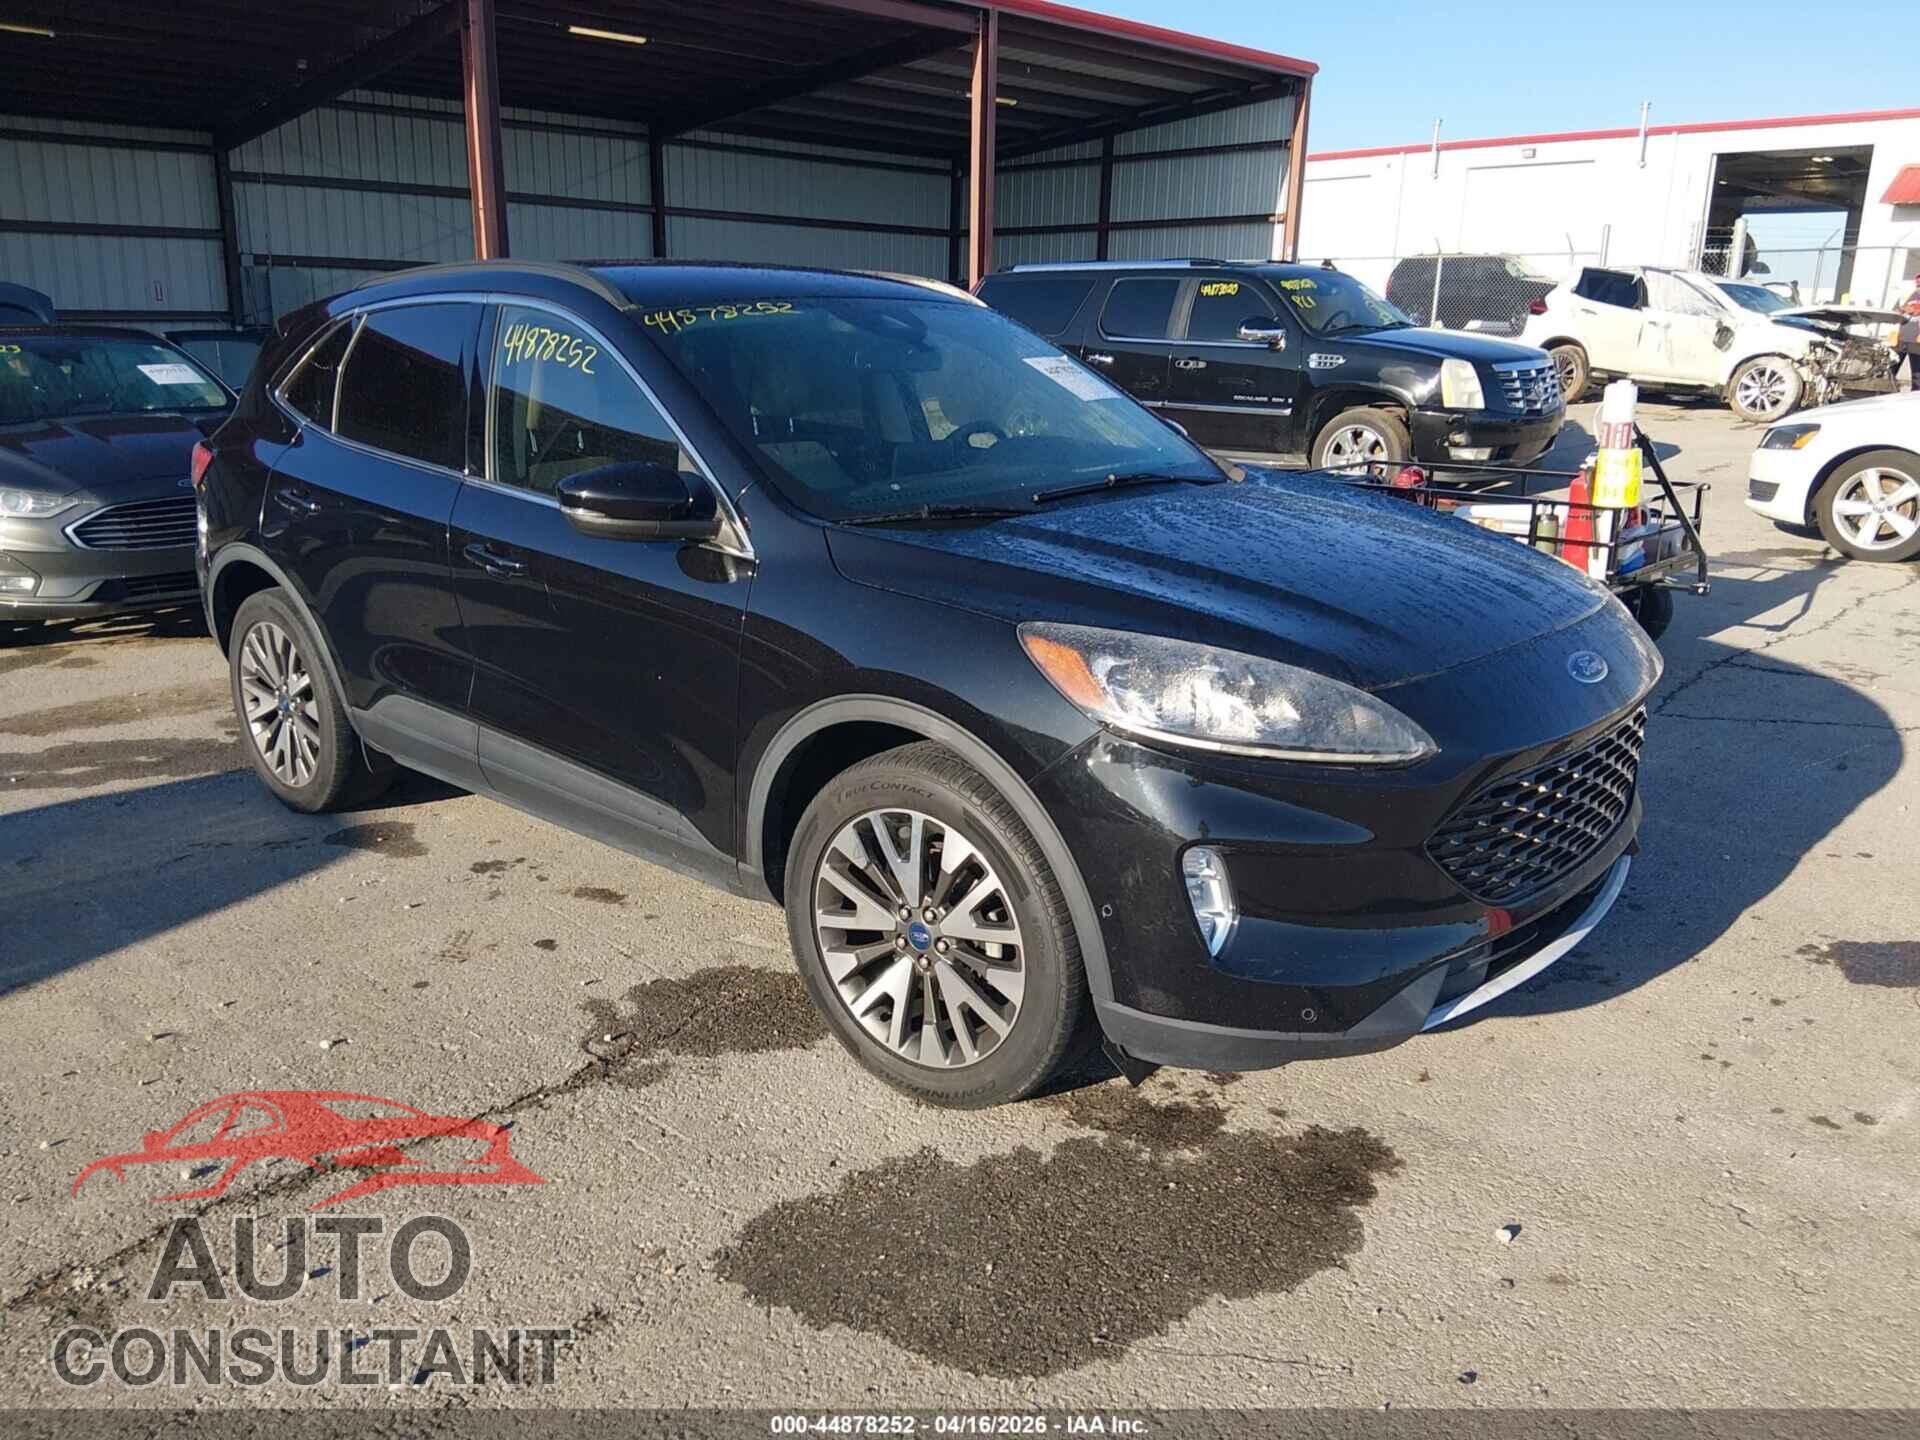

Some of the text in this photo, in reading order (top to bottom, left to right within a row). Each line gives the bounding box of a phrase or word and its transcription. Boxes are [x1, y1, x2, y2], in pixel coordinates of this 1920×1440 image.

[644, 302, 804, 335] 44878252
[504, 323, 598, 375] 44878252
[882, 1072, 996, 1100] CONTINE
